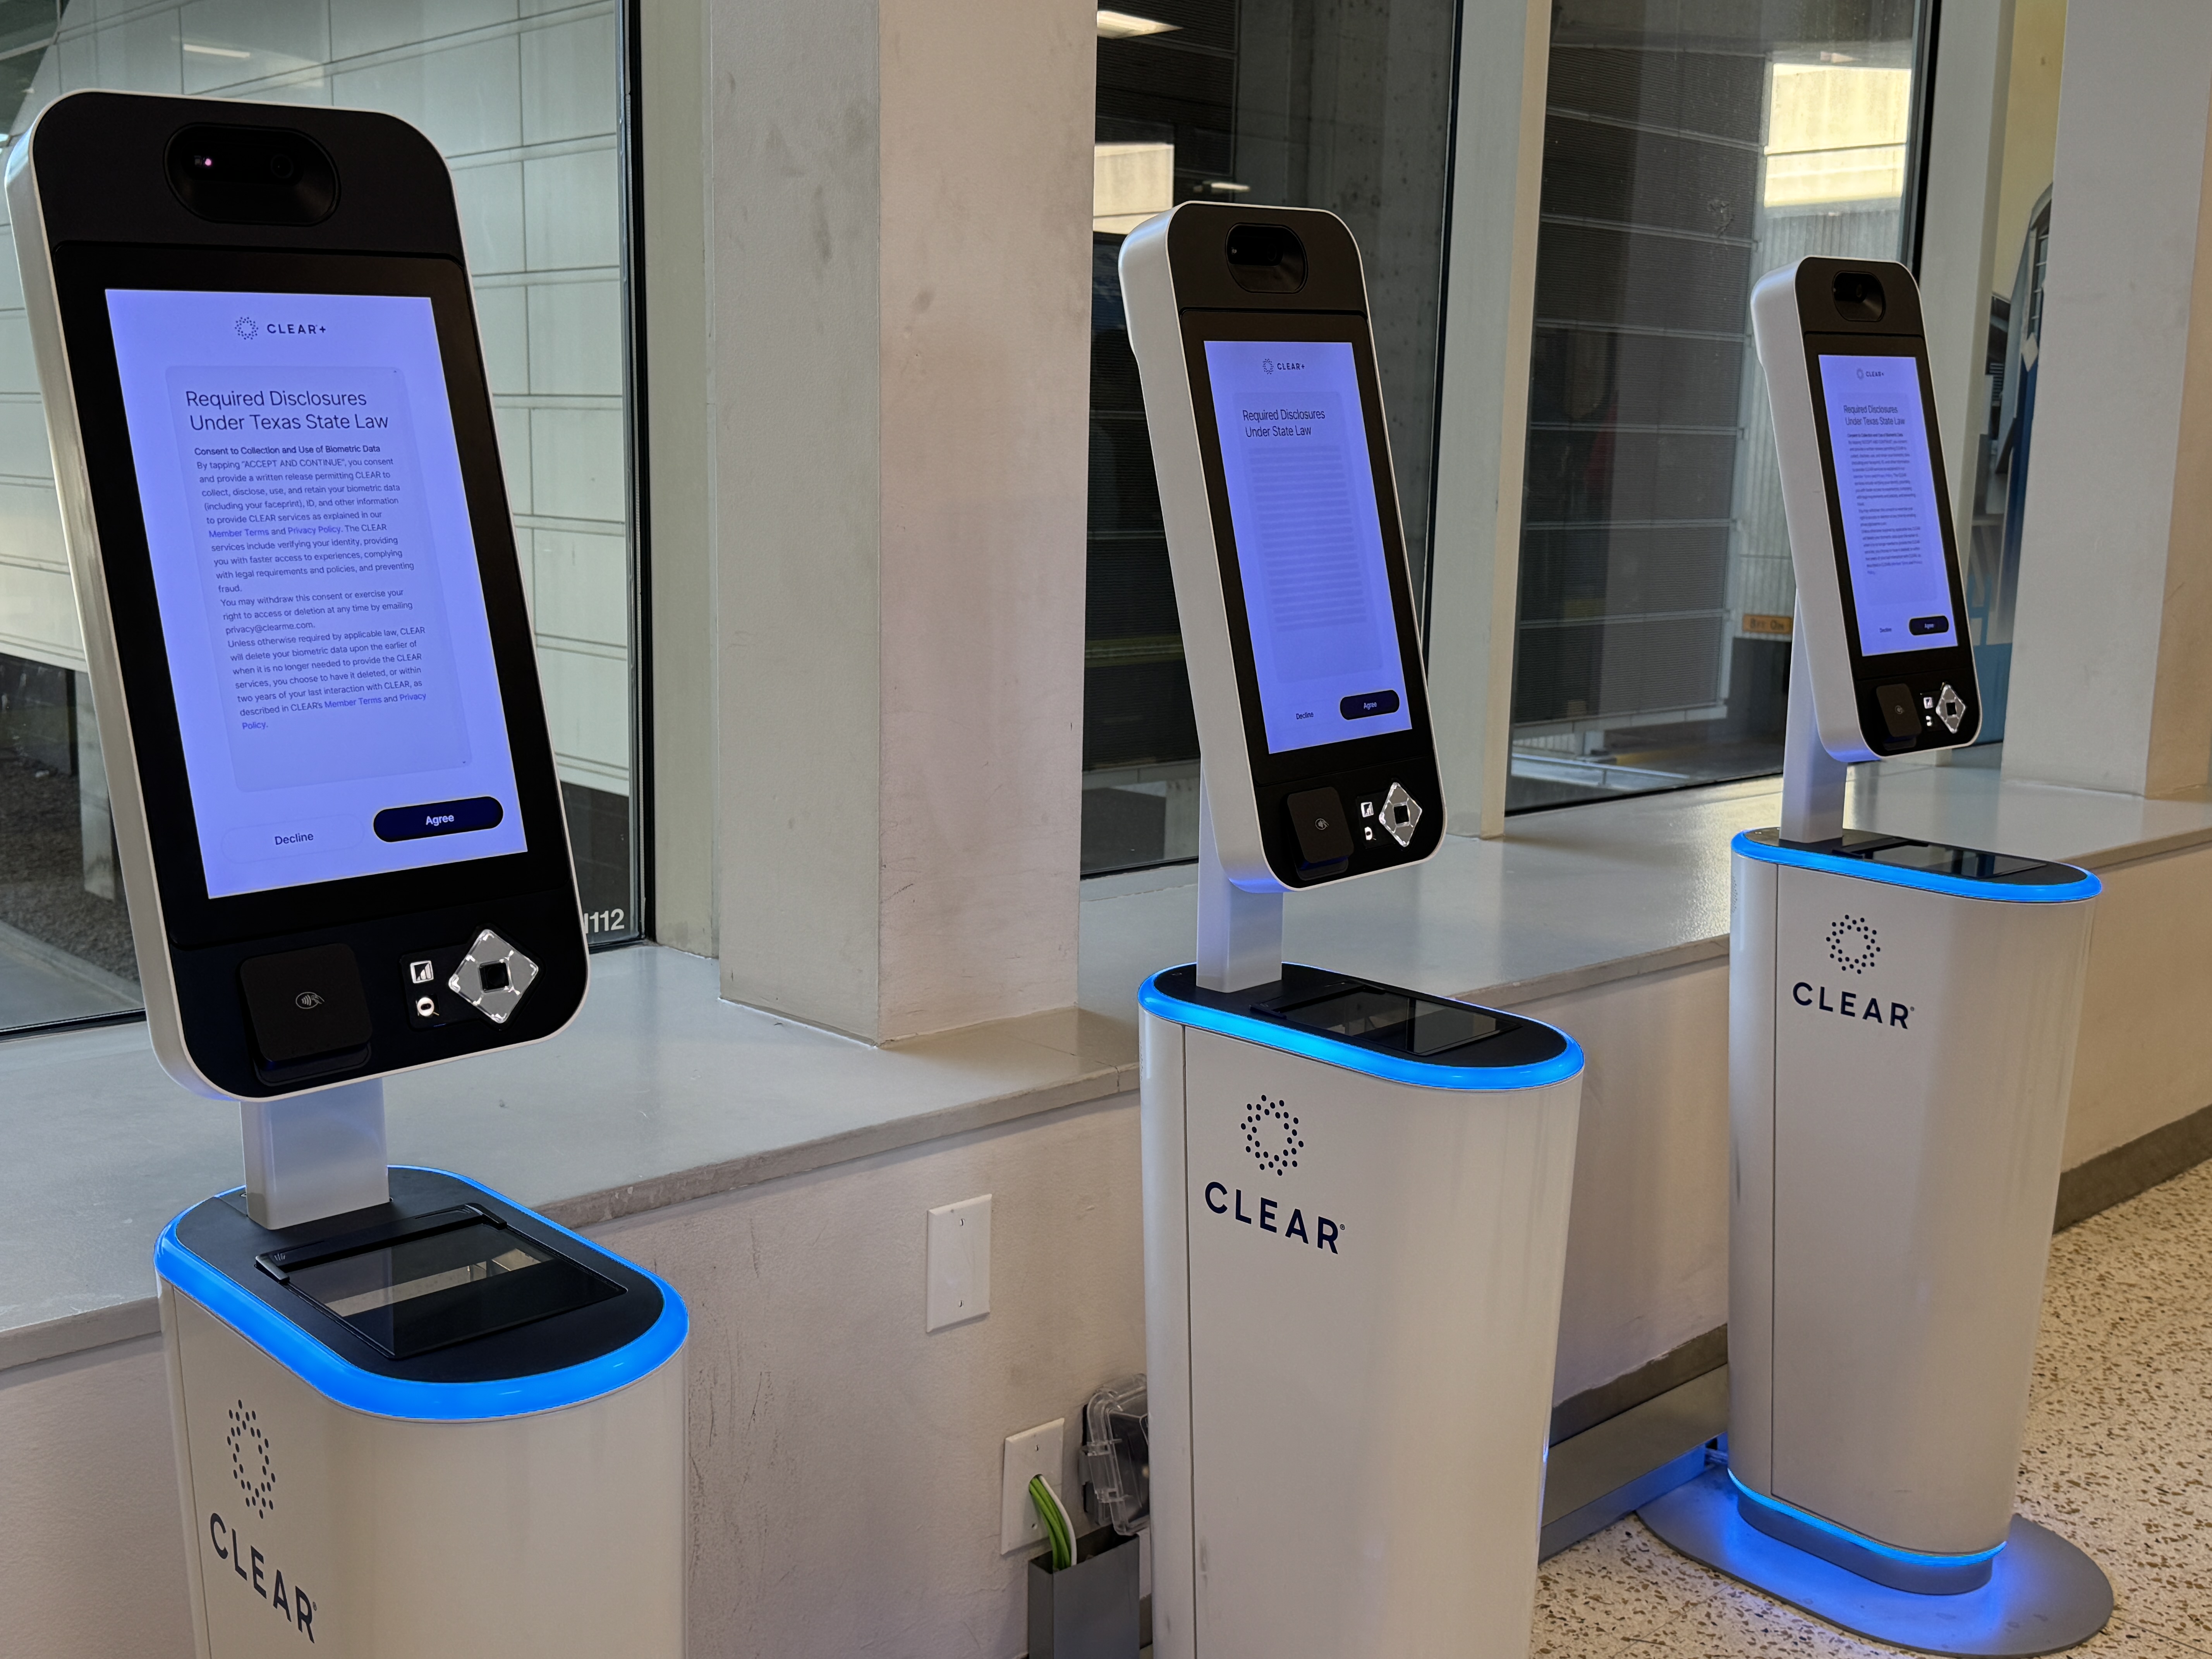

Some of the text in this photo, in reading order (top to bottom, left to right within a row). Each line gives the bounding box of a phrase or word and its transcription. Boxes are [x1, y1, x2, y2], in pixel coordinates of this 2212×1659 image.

[267, 324, 326, 334] CLEAR+
[185, 390, 367, 410] Required Disclosures
[1242, 409, 1325, 423] Required Disclosures
[1843, 405, 1898, 414] Required Disclosures
[189, 413, 388, 430] Under Texas State Law
[1845, 417, 1905, 425] Under Texas State Law
[1245, 425, 1311, 437] Under State Law
[194, 447, 229, 455] Consent
[240, 446, 280, 455] Collection
[315, 445, 323, 453] of
[325, 445, 361, 453] Biometric
[196, 461, 208, 471] By
[209, 461, 240, 470] tapping
[280, 459, 297, 467] AND
[347, 459, 362, 467] you
[216, 474, 247, 484] provide
[314, 472, 354, 481] permitting
[355, 471, 381, 479] CLEAR
[201, 489, 231, 497] collect,
[232, 488, 268, 496] disclose,
[287, 486, 302, 494] and
[304, 485, 326, 493] retain
[327, 486, 345, 494] your
[346, 484, 382, 492] biometric
[244, 502, 263, 510] your
[306, 499, 317, 508] ID,
[356, 497, 399, 505] information
[208, 529, 242, 538] Member
[244, 528, 270, 536] Terms
[271, 527, 286, 535] and
[287, 527, 316, 535] Privacy
[318, 525, 343, 534] Policy.
[361, 523, 387, 531] CLEAR
[211, 536, 398, 551] services include verifying your identity, providing
[213, 559, 228, 567] you
[314, 552, 362, 562] experiences,
[364, 549, 403, 559] complying
[215, 562, 414, 579] with legal requirements and policies, and preventing
[218, 584, 242, 593] fraud.
[256, 596, 294, 604] withdraw
[295, 594, 311, 602] this
[311, 592, 343, 601] consent
[354, 590, 386, 598] exercise
[387, 589, 404, 598] your
[227, 639, 256, 647] Unless
[257, 636, 296, 646] otherwise
[298, 633, 330, 643] required
[332, 633, 342, 641] by
[344, 630, 382, 640] applicable
[400, 626, 426, 635] CLEAR
[284, 663, 309, 672] longer
[311, 659, 341, 668] needed
[352, 656, 381, 667] provide
[396, 653, 422, 662] CLEAR
[235, 680, 271, 689] services,
[272, 679, 288, 687] you
[289, 676, 318, 684] choose
[357, 669, 388, 678] deleted,
[398, 666, 421, 675] within
[254, 693, 276, 703] years
[278, 690, 286, 699] of
[288, 690, 306, 700] your
[323, 685, 365, 694] interaction
[366, 682, 383, 690] with
[383, 680, 412, 689] CLEAR,
[239, 705, 280, 716] described
[324, 699, 356, 708] Member
[383, 694, 398, 703] and
[399, 693, 426, 701] Privacy
[1364, 702, 1377, 710] Agree
[242, 721, 268, 730] Policy.
[426, 815, 454, 826] Agree
[275, 833, 314, 845] Decline
